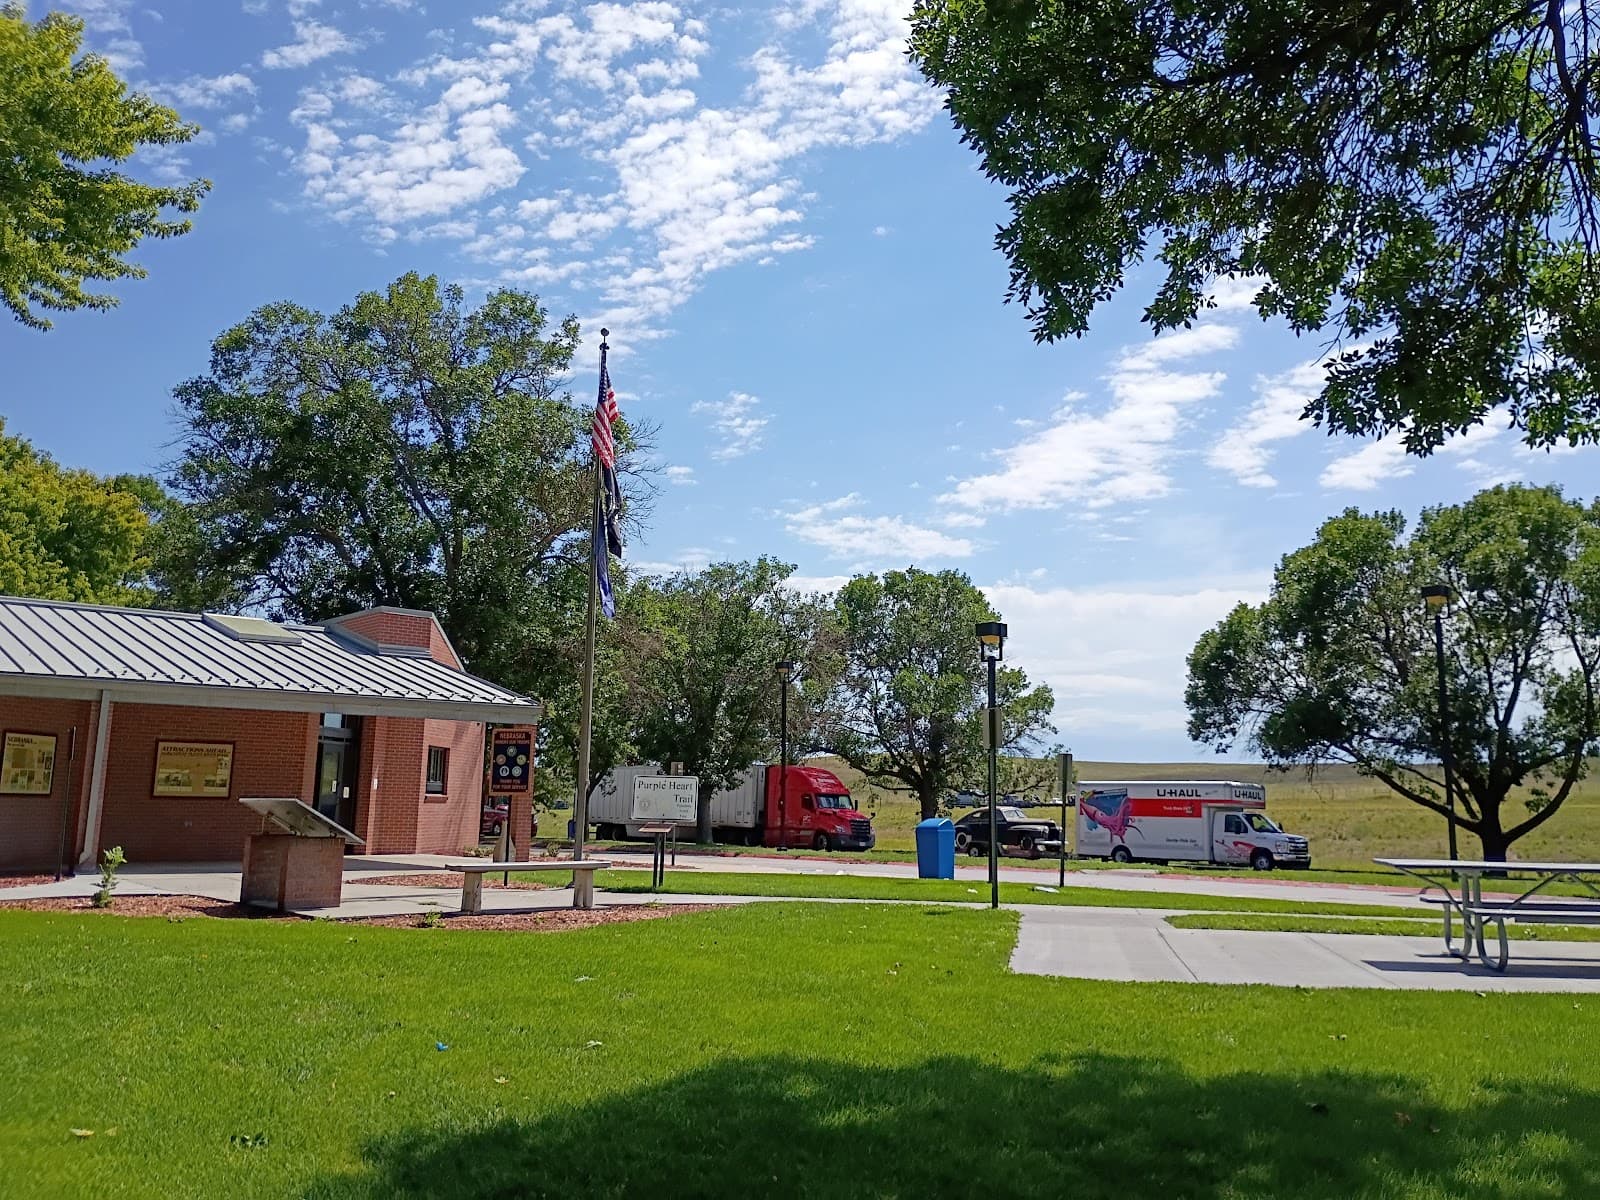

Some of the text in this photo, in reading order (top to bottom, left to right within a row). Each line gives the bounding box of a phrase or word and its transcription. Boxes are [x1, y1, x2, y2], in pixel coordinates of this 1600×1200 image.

[638, 780, 693, 791] Purple Heart
[1157, 789, 1202, 797] U-HAUL
[1234, 790, 1262, 800] U-HAUL
[673, 794, 693, 803] Trail
